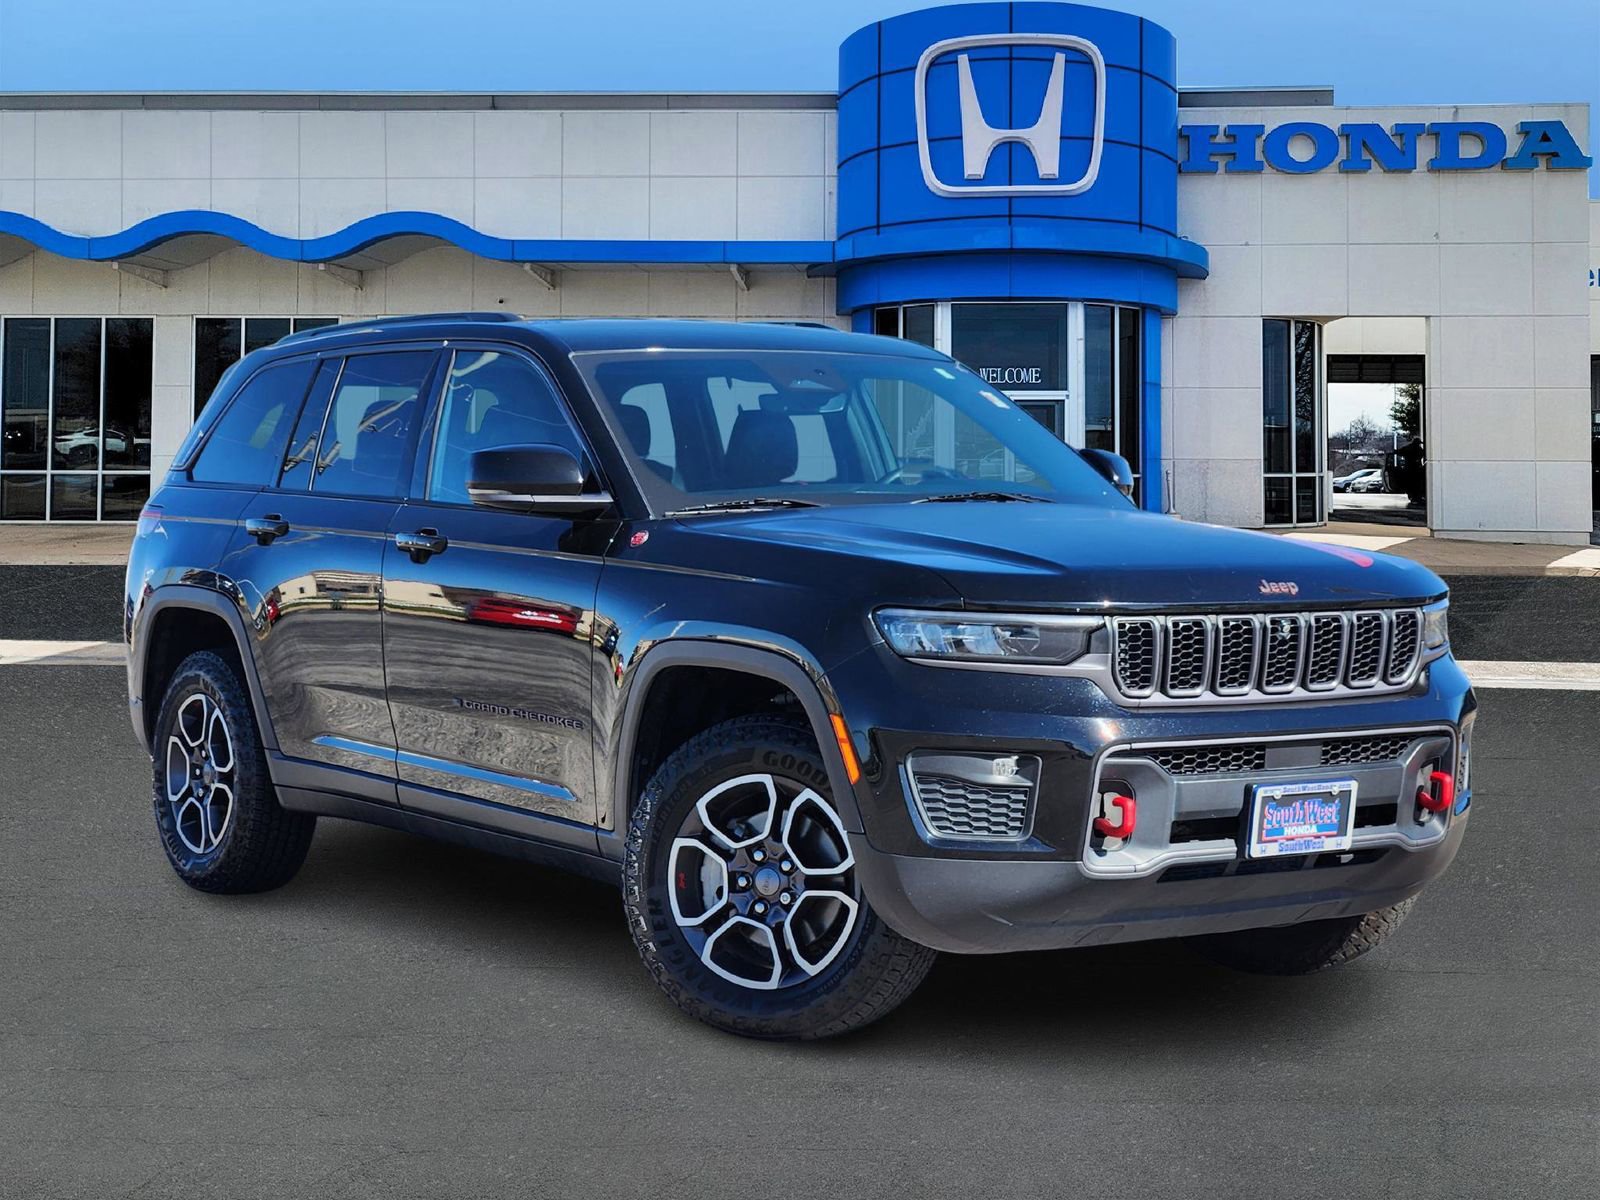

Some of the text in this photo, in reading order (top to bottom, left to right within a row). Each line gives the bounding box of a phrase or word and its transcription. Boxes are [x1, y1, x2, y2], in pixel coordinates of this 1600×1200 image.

[1180, 120, 1593, 174] HONDA
[979, 367, 1041, 384] WELCOME
[1259, 579, 1299, 596] Jeep
[463, 700, 584, 730] GRAND CHEROKEE
[1283, 825, 1318, 836] HONDA
